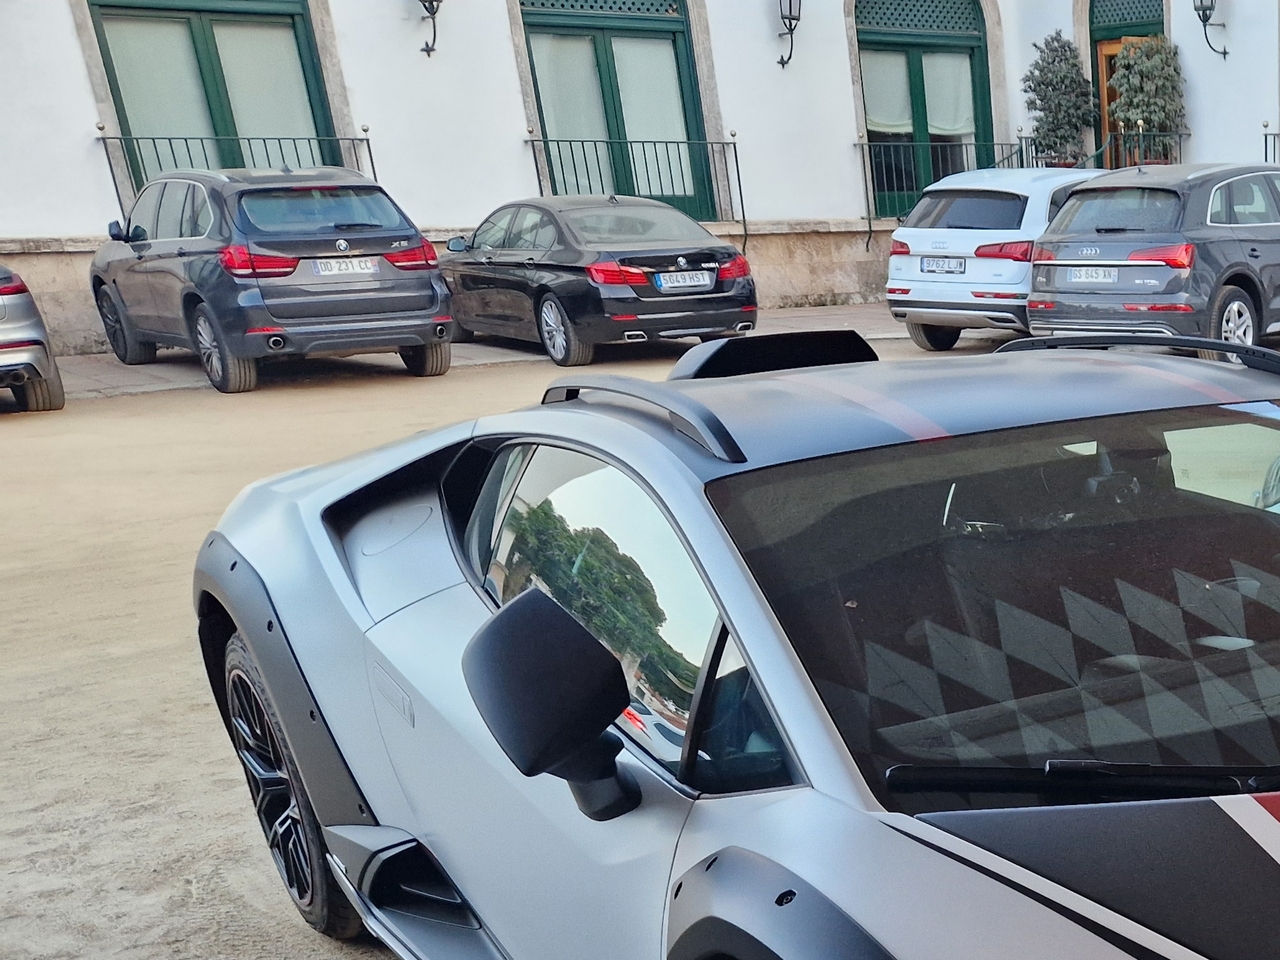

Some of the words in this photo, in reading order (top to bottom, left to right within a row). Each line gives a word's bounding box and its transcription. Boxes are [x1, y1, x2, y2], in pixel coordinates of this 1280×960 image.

[926, 259, 945, 269] 9762
[662, 273, 687, 285] 5649
[689, 272, 707, 283] HST
